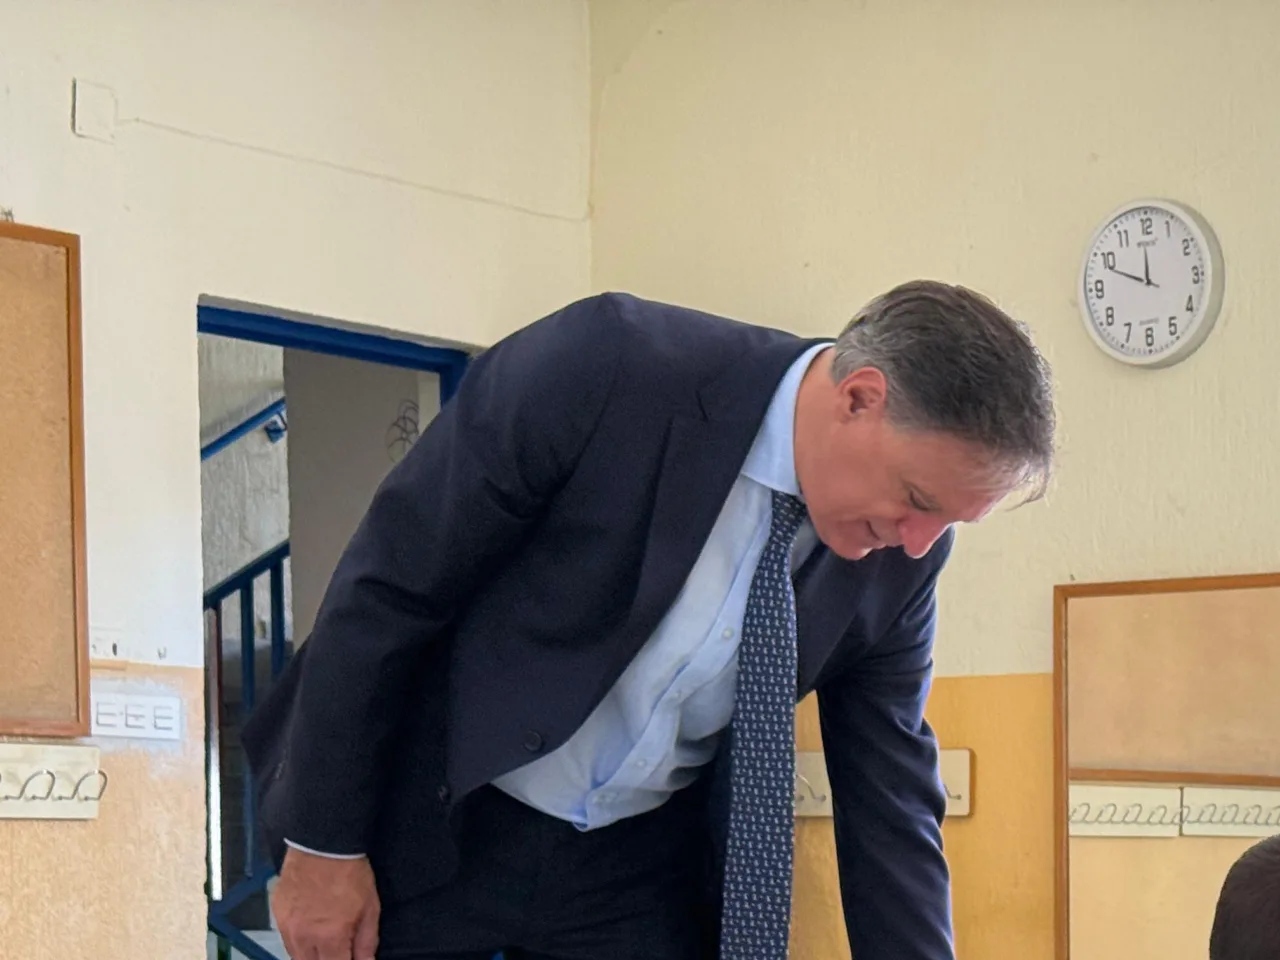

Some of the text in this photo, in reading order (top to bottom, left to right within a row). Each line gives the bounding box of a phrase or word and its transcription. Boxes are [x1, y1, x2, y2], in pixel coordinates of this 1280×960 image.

[1140, 217, 1153, 235] 12
[1165, 220, 1171, 238] 1
[1117, 229, 1129, 248] 11
[1182, 238, 1191, 256] 2
[1101, 251, 1116, 270] 10
[1191, 265, 1200, 284] 3
[1094, 279, 1104, 299] 9
[1185, 295, 1194, 312] 4
[1105, 306, 1115, 326] 8
[1123, 322, 1132, 344] 7
[1168, 316, 1178, 336] 5
